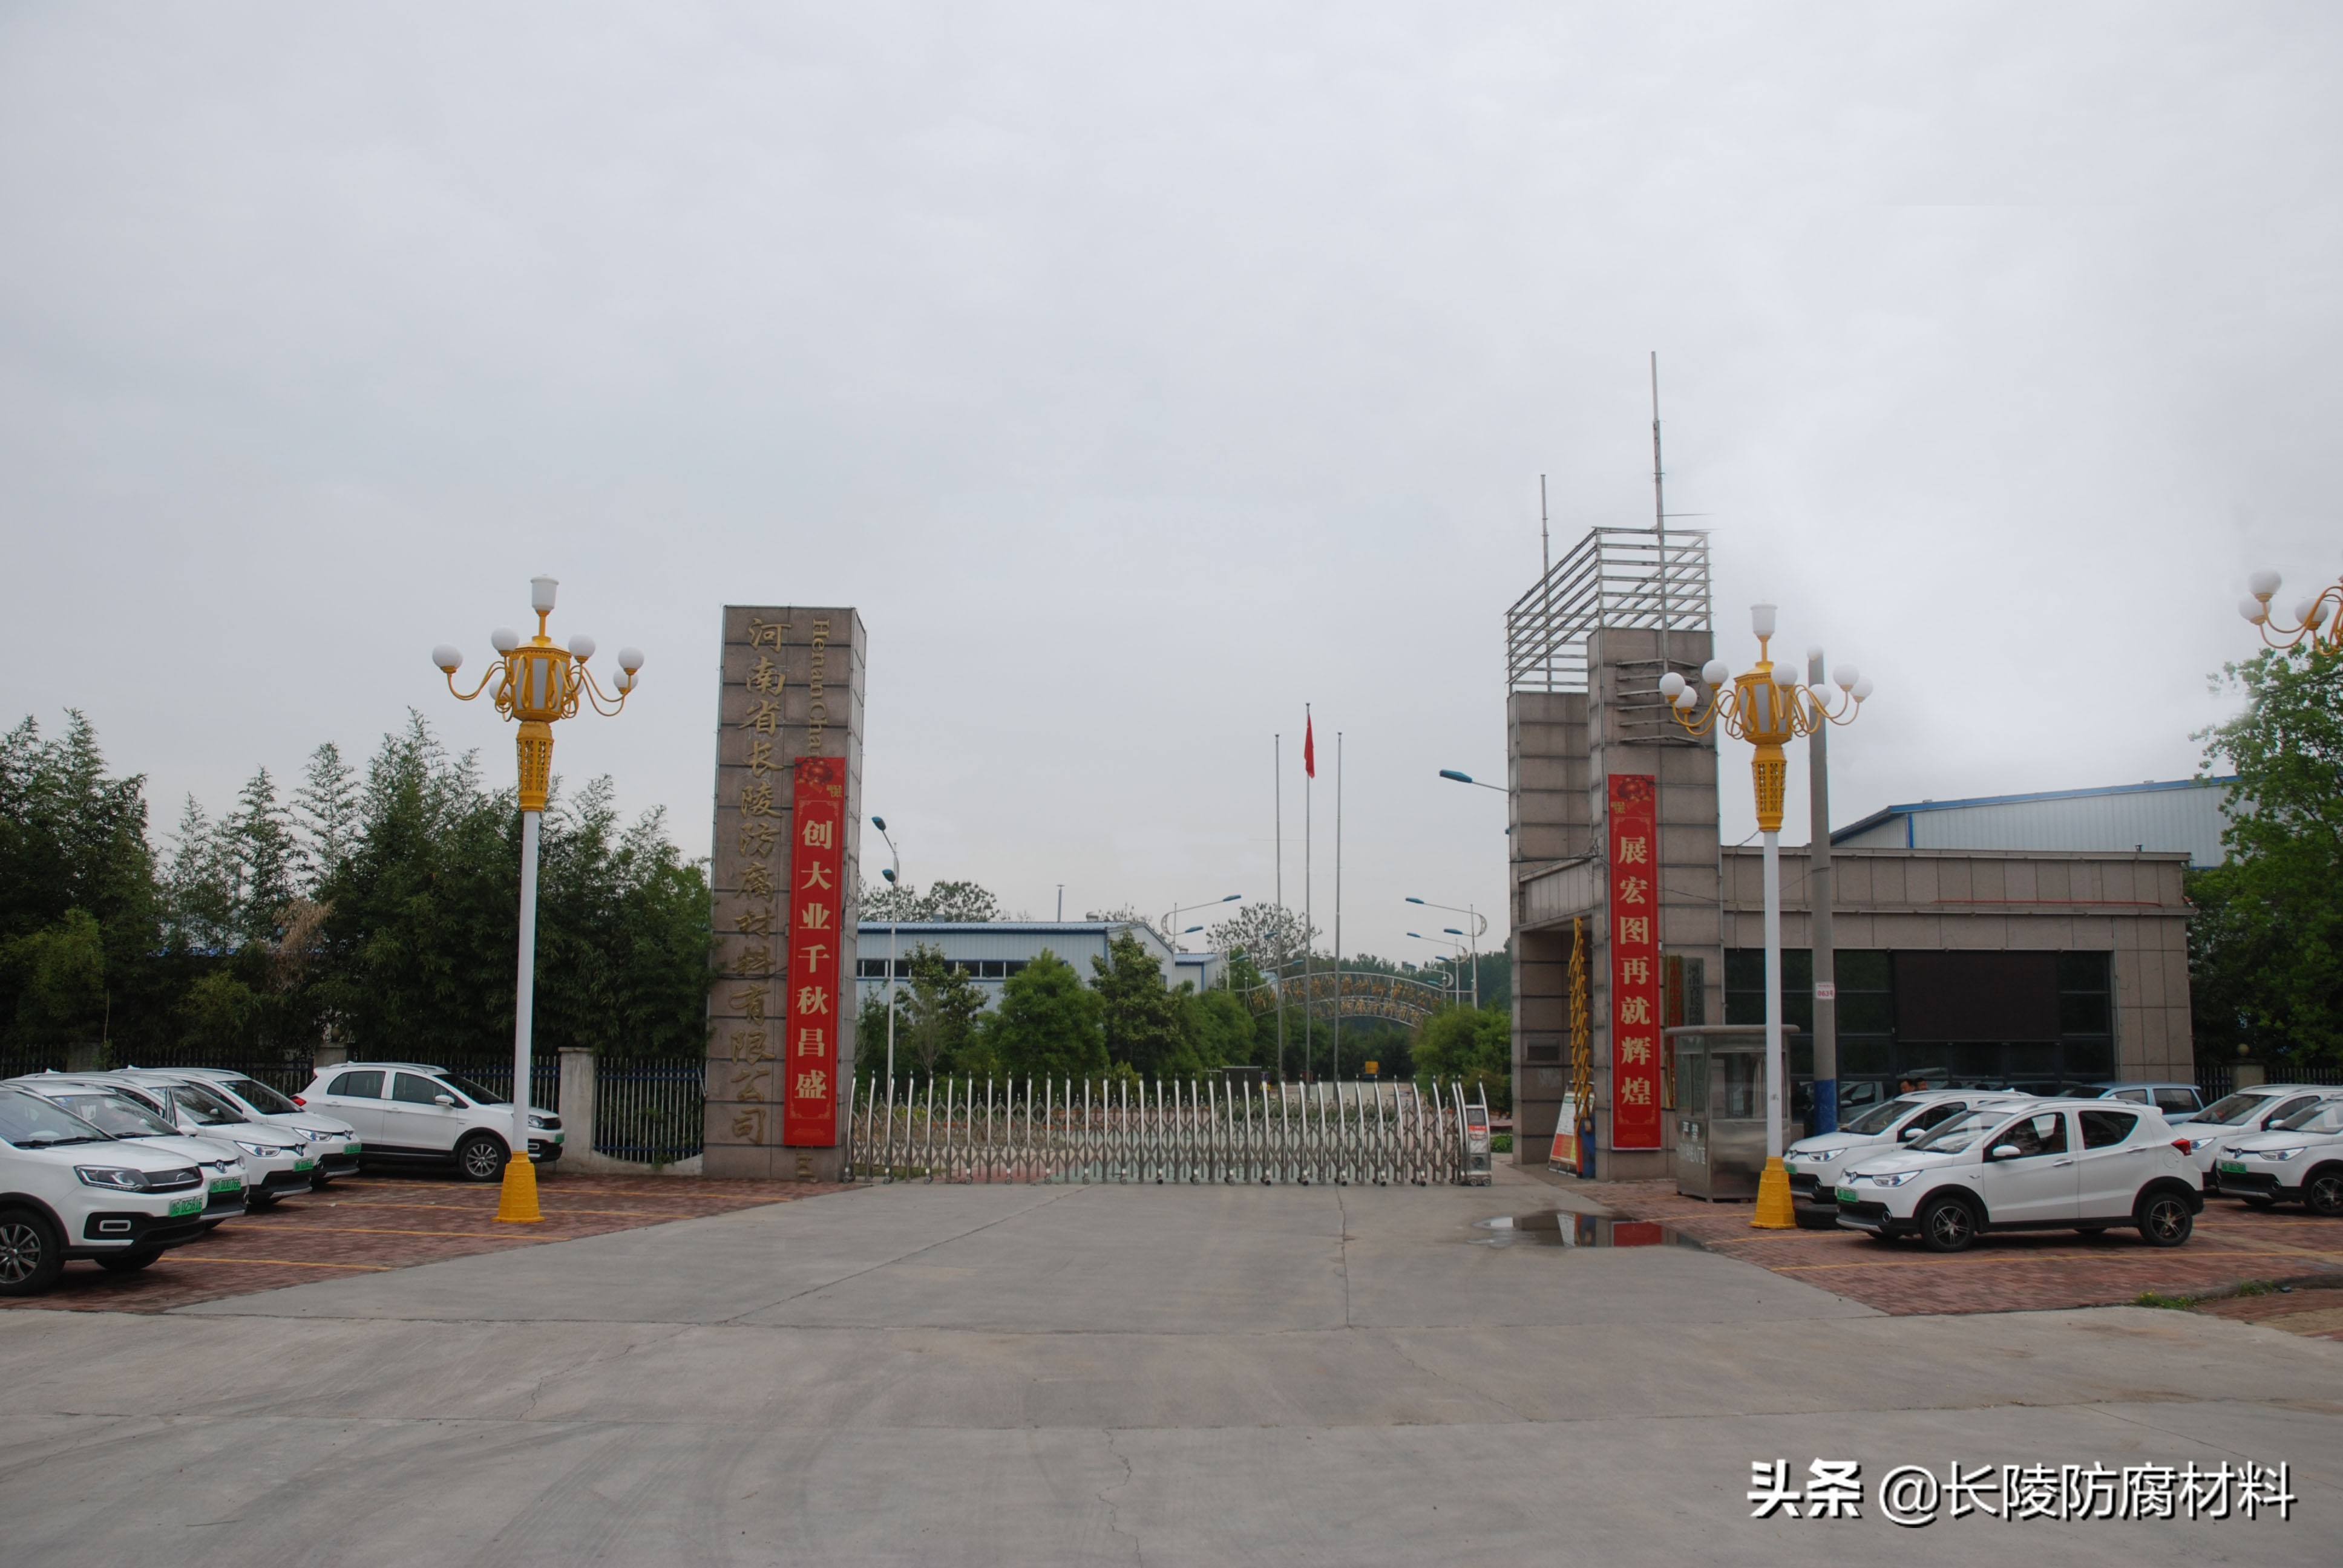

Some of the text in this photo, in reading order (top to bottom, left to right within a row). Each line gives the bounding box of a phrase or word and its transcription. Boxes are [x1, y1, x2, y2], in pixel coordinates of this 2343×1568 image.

[729, 617, 792, 1145] 河南省长陵防腐材料有限公司
[794, 820, 834, 1099] 创大业千秋昌盛
[1617, 836, 1652, 1106] 展宏图再就辉煌
